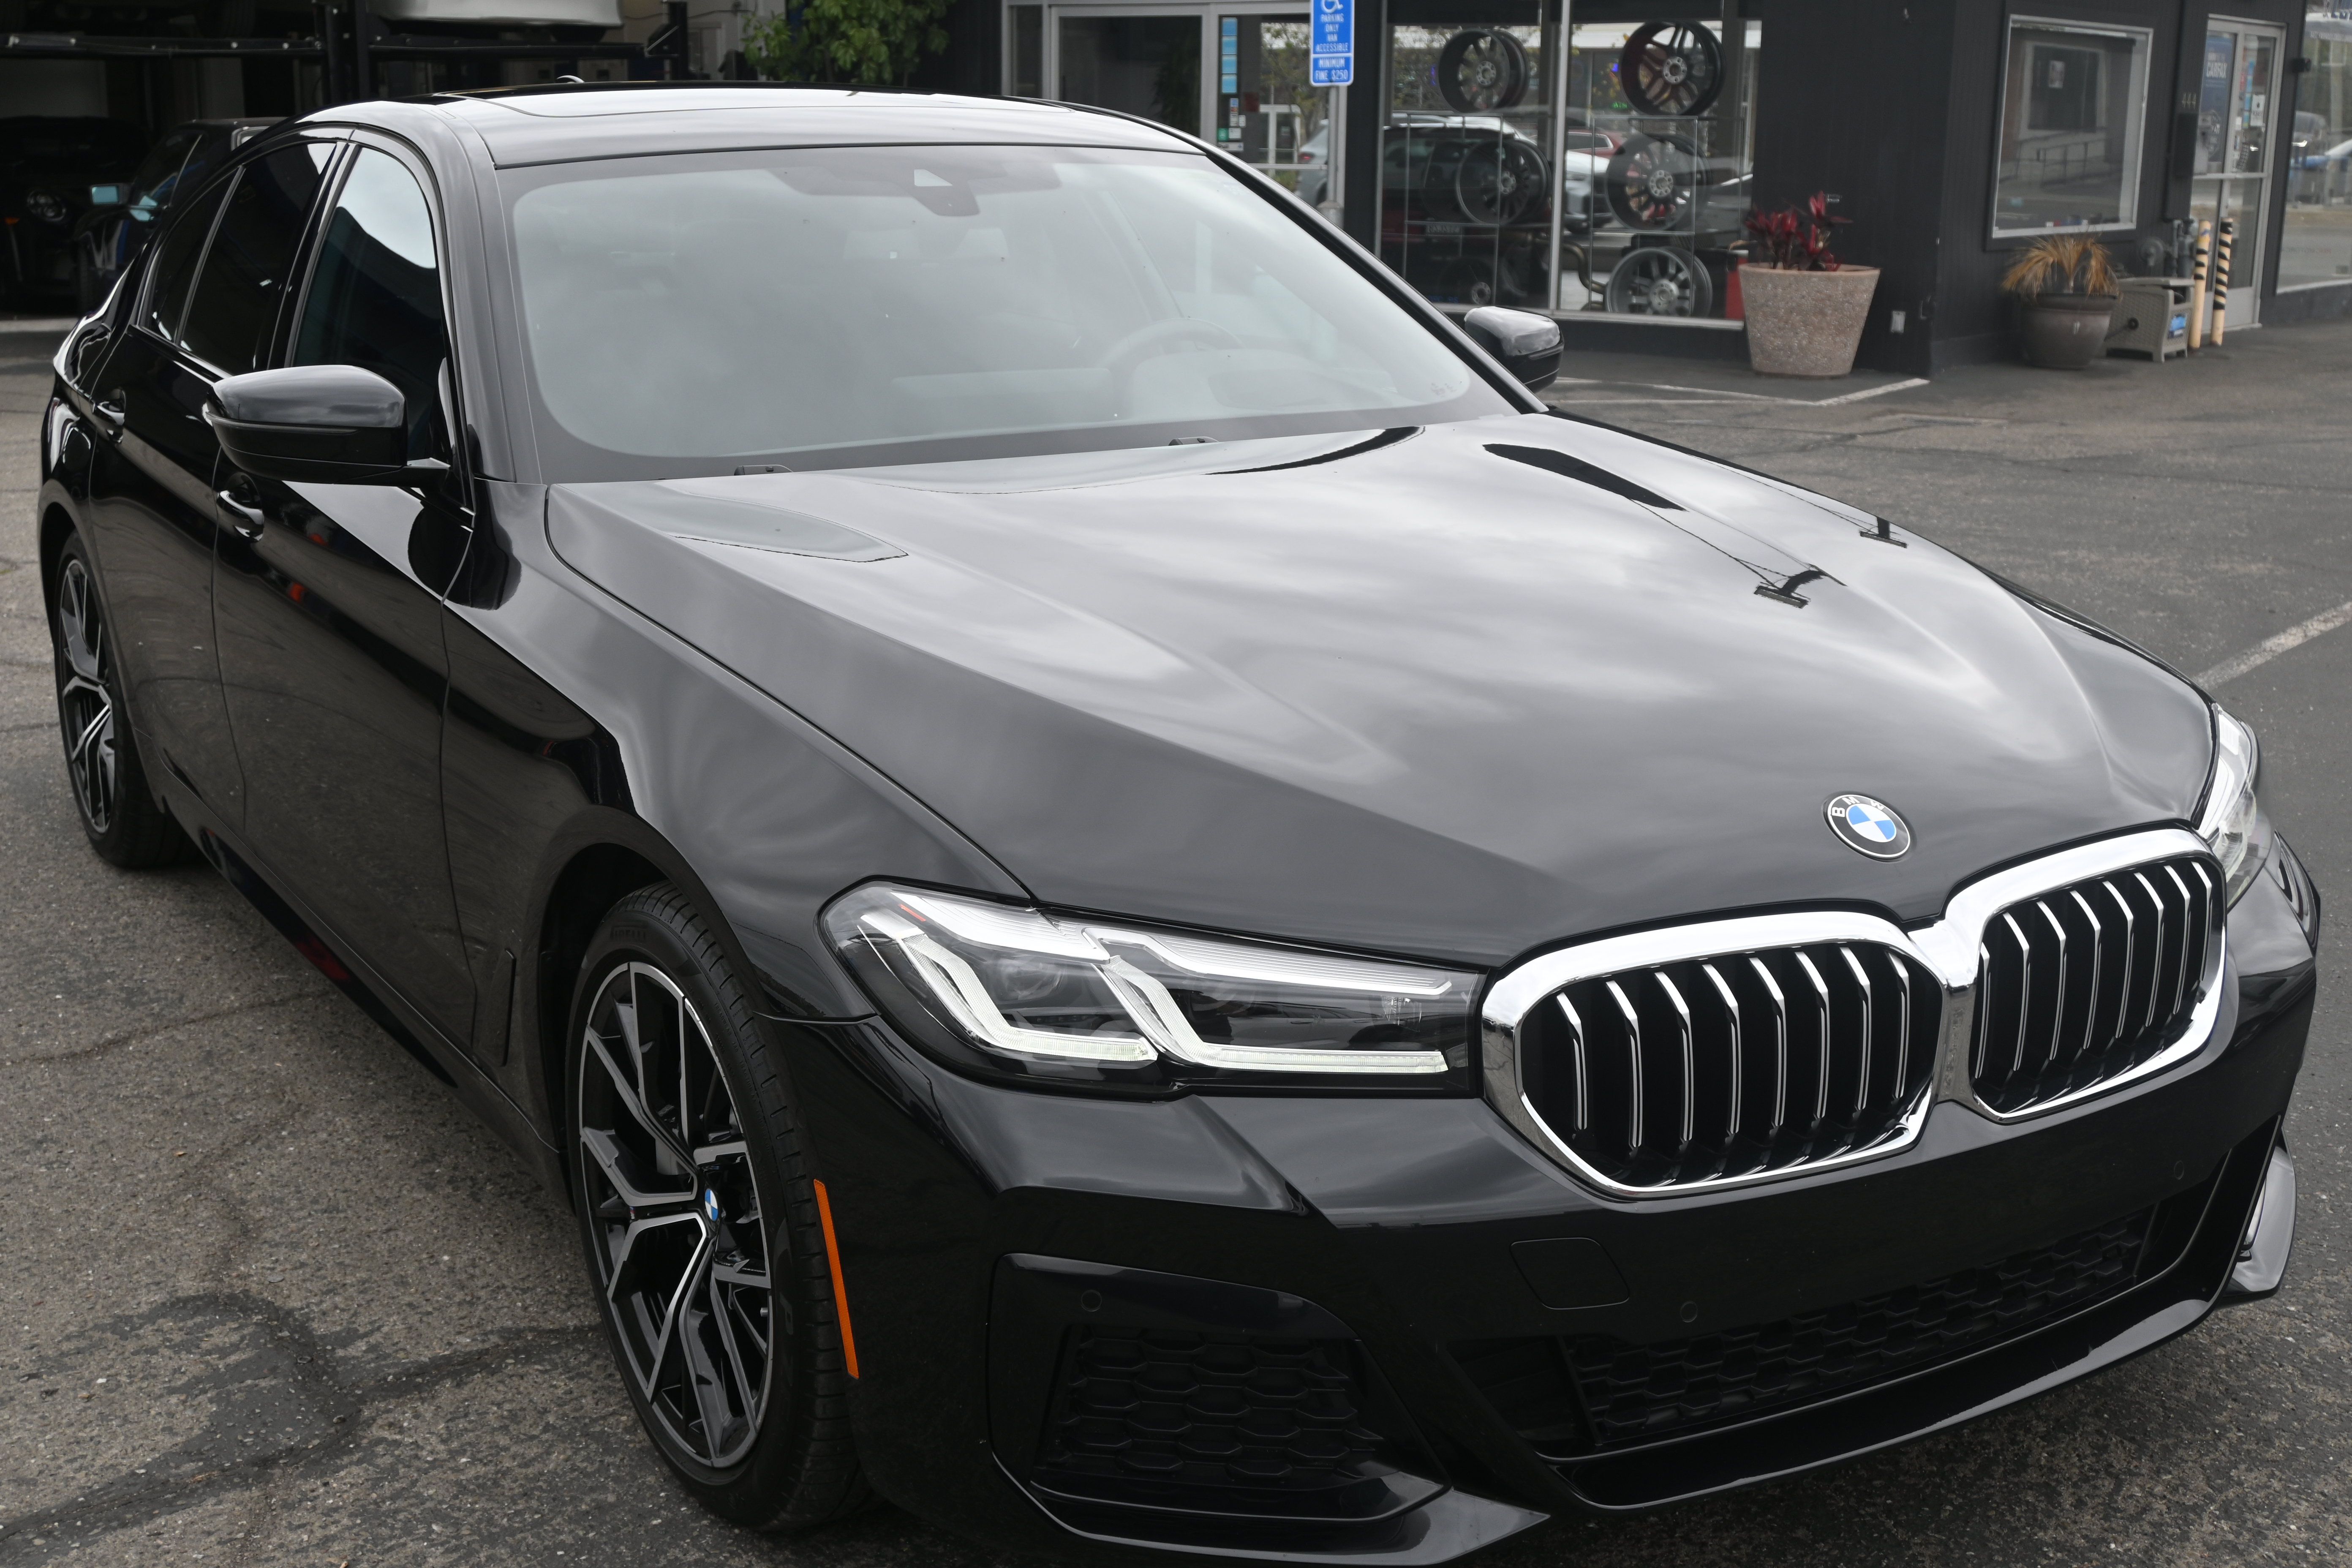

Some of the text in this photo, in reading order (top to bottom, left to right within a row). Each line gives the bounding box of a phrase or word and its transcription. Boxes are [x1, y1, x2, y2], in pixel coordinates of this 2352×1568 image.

[1321, 13, 1344, 22] PARKING
[1326, 24, 1339, 32] ONLY
[1328, 33, 1338, 41] VAN
[1316, 43, 1348, 52] ACCESSIBLE
[1319, 57, 1345, 68] MINIMUM
[1315, 69, 1348, 80] FINE $250
[2206, 62, 2227, 79] CARFAX
[2182, 93, 2197, 110] 444
[1831, 796, 1885, 818] BMW
